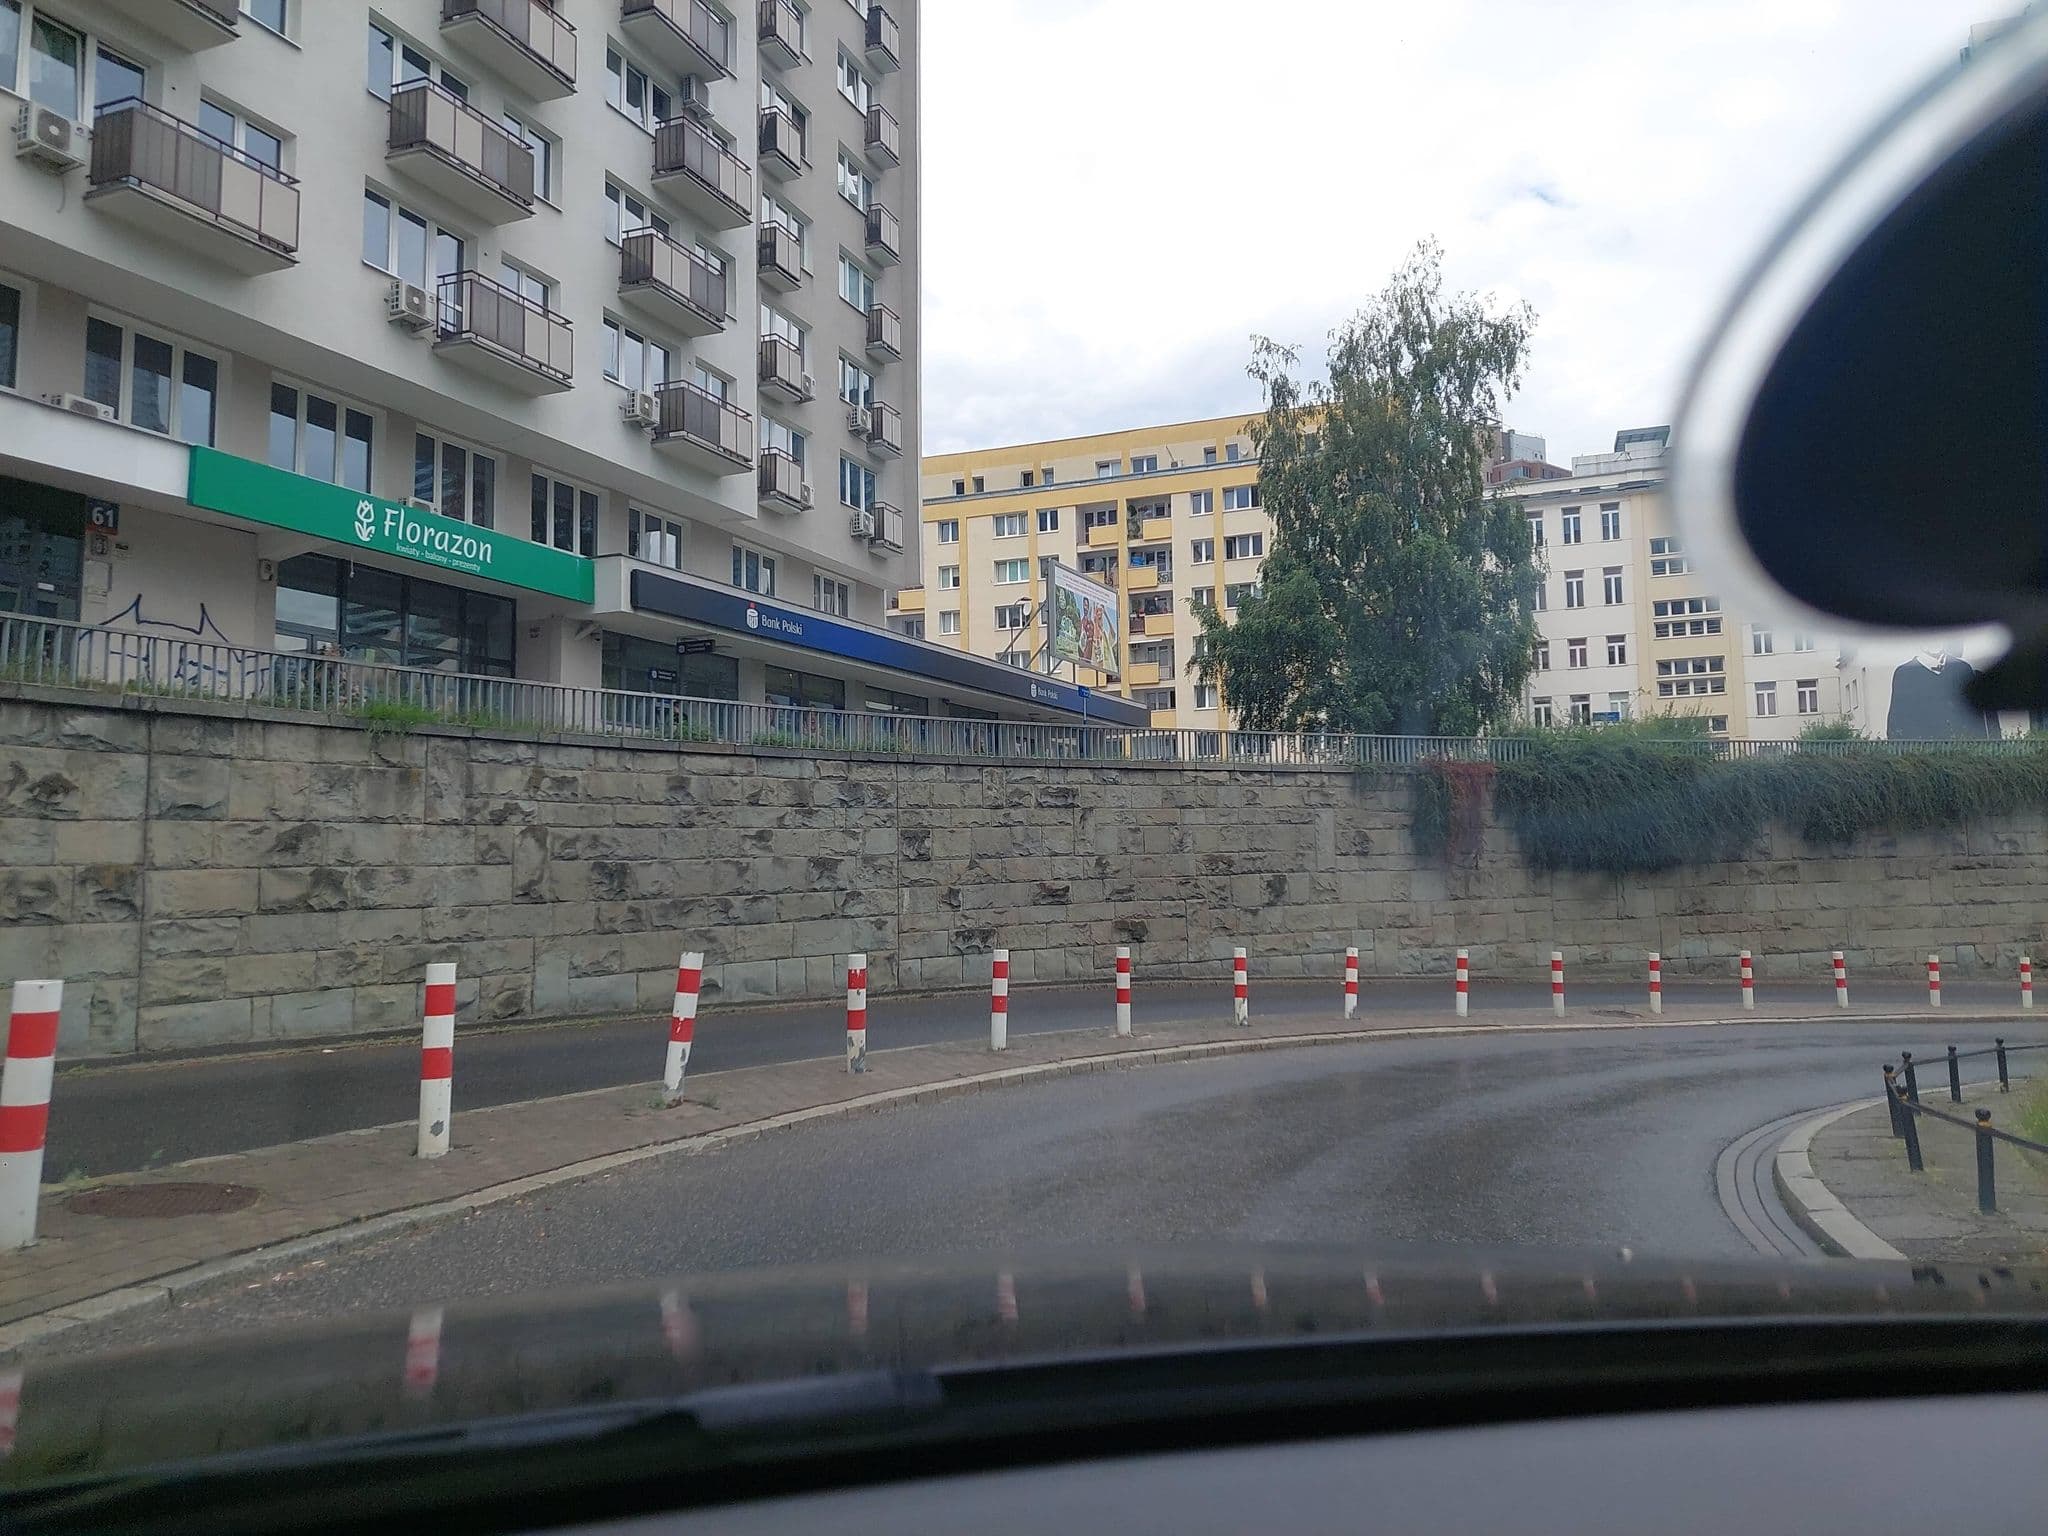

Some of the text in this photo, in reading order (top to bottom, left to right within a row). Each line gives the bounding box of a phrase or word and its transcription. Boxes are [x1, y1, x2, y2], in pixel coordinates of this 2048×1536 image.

[92, 507, 114, 528] 61
[384, 507, 493, 564] Florazon
[396, 542, 419, 557] kwiaty
[425, 549, 447, 564] balony
[761, 614, 803, 636] Bank Polski
